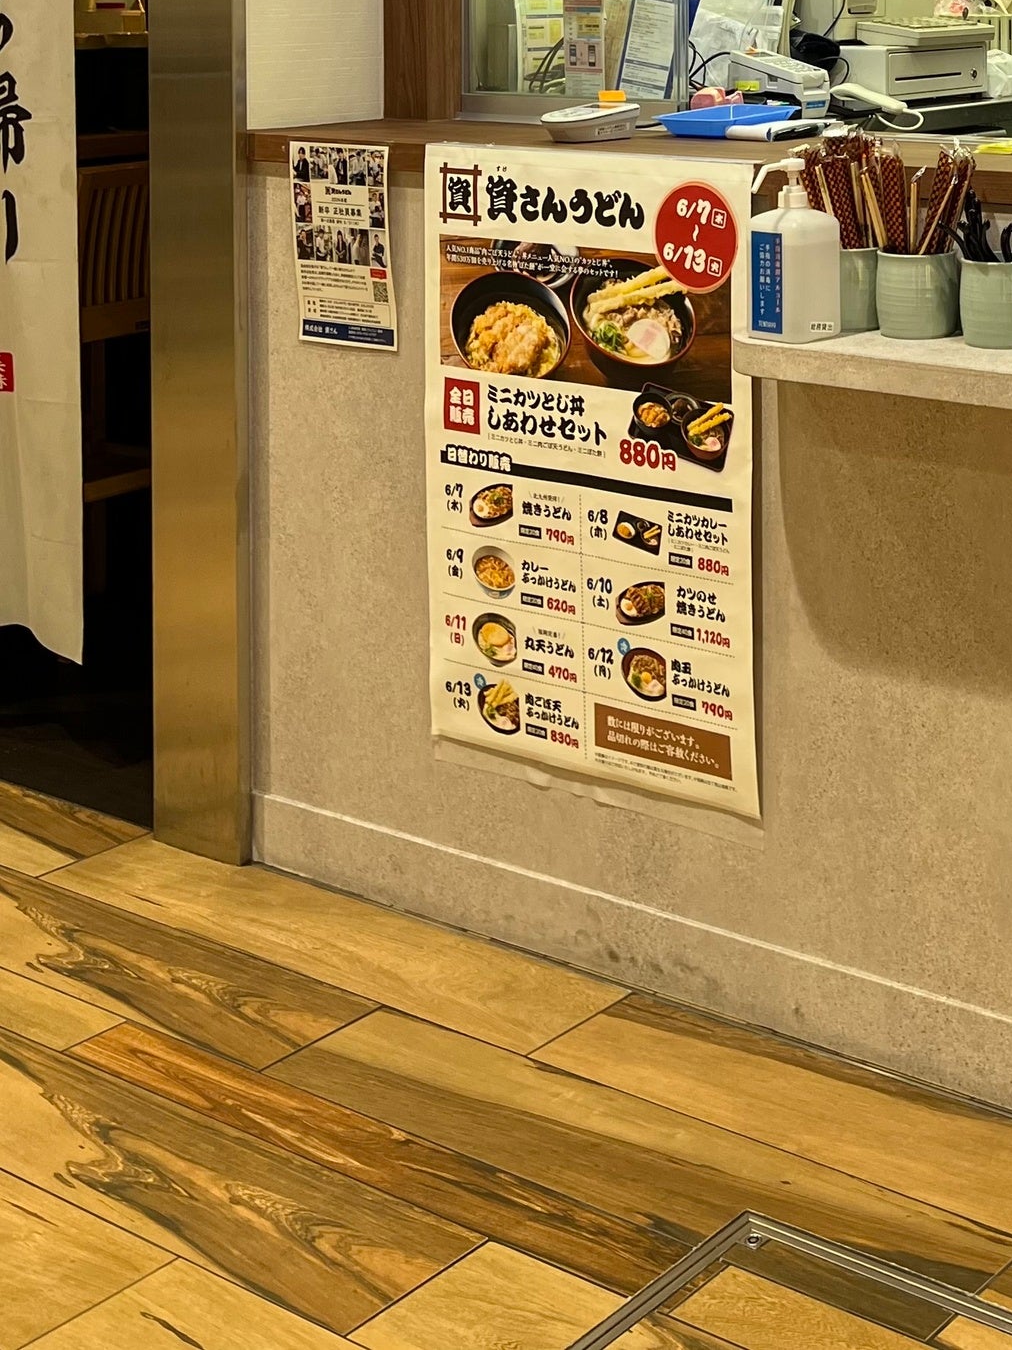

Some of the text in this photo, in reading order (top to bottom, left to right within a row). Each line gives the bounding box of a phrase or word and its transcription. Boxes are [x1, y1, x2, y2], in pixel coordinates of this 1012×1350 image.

[448, 175, 645, 230] 資 資さんうどん
[677, 199, 711, 224] 6/7
[663, 242, 706, 273] 6/13
[450, 386, 473, 407] 全日
[487, 385, 585, 416] ミニカツとじ丼
[450, 405, 474, 426] 販売
[487, 407, 607, 446] しあわせセット
[447, 445, 512, 472] 日替わり販売
[619, 439, 676, 471] 880円
[445, 483, 463, 498] 6/7
[522, 501, 572, 521] 焼きうどん
[588, 509, 608, 524] 6/8
[668, 511, 727, 529] ミニカツカレー
[546, 528, 574, 546] 790円
[668, 524, 728, 546] しあわせセット
[446, 548, 464, 563] 6/9
[521, 560, 549, 571] カレー
[698, 557, 729, 576] 880円
[521, 573, 576, 593] ぶっかけうどん
[587, 577, 612, 594] 6/10
[676, 586, 717, 605] カツのせ
[547, 597, 576, 615] 620円
[676, 600, 725, 623] 焼きうどん
[445, 614, 466, 631] 6/11
[524, 636, 574, 659] 丸天うどん
[696, 628, 730, 648] 1,120円
[588, 647, 613, 665] 6/12
[548, 665, 577, 683] 470円
[445, 681, 472, 696] 6/13
[672, 674, 730, 698] ぶっかけうどん
[525, 693, 561, 712] 肉ごぼ天
[702, 701, 733, 721] 790円
[526, 708, 579, 730] ぶっかけうどん
[550, 730, 579, 749] 830円
[607, 715, 700, 749] 数には限りがございます。
